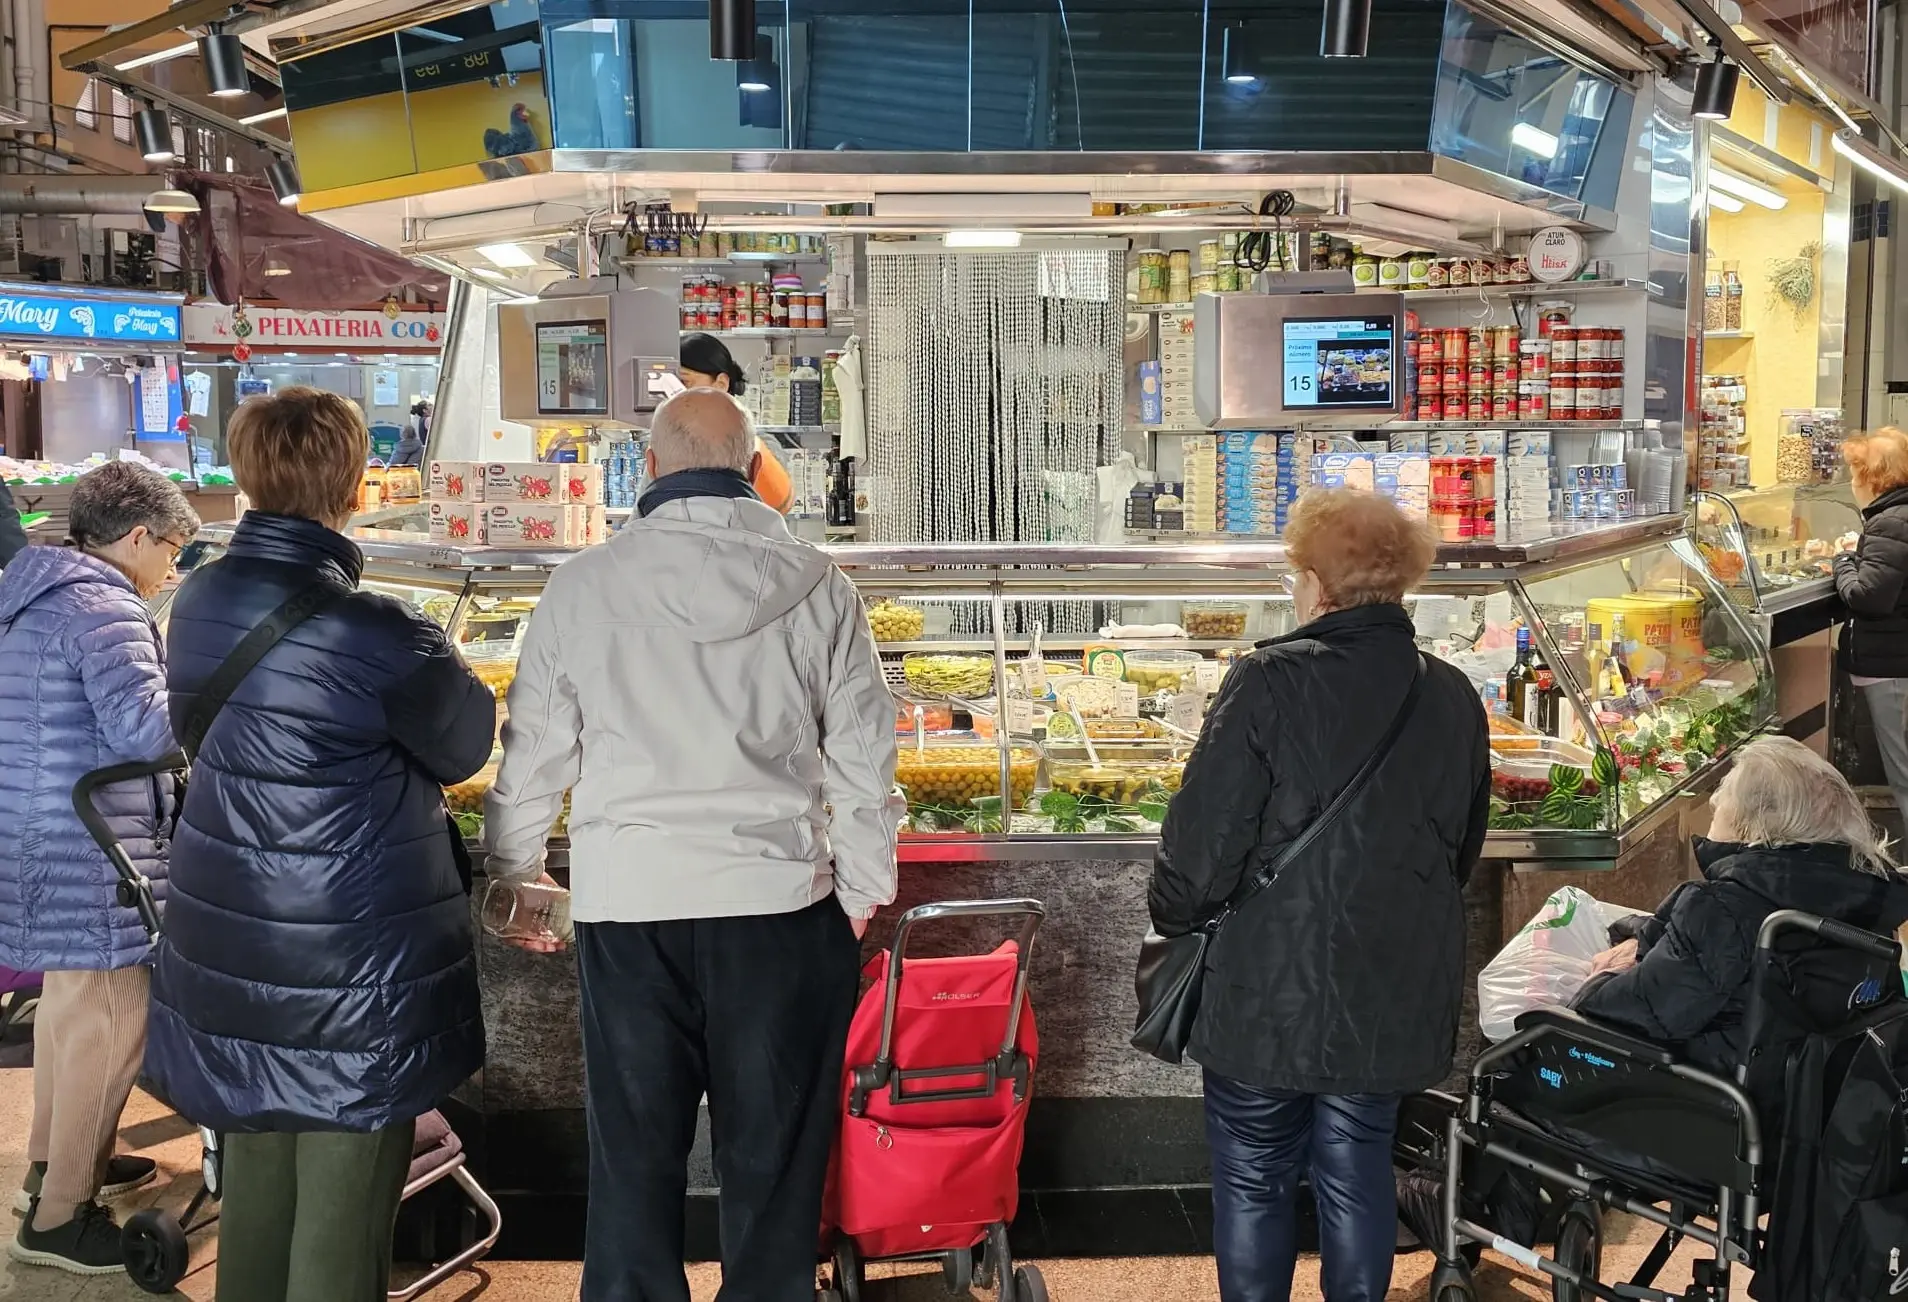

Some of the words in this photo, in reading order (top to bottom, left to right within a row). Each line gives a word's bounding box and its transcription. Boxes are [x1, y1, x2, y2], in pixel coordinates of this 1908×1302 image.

[1545, 238, 1566, 246] CLARO
[0, 300, 60, 332] Mary
[258, 316, 384, 338] PEIXATERIA
[543, 380, 556, 395] 15
[1290, 375, 1311, 391] 15
